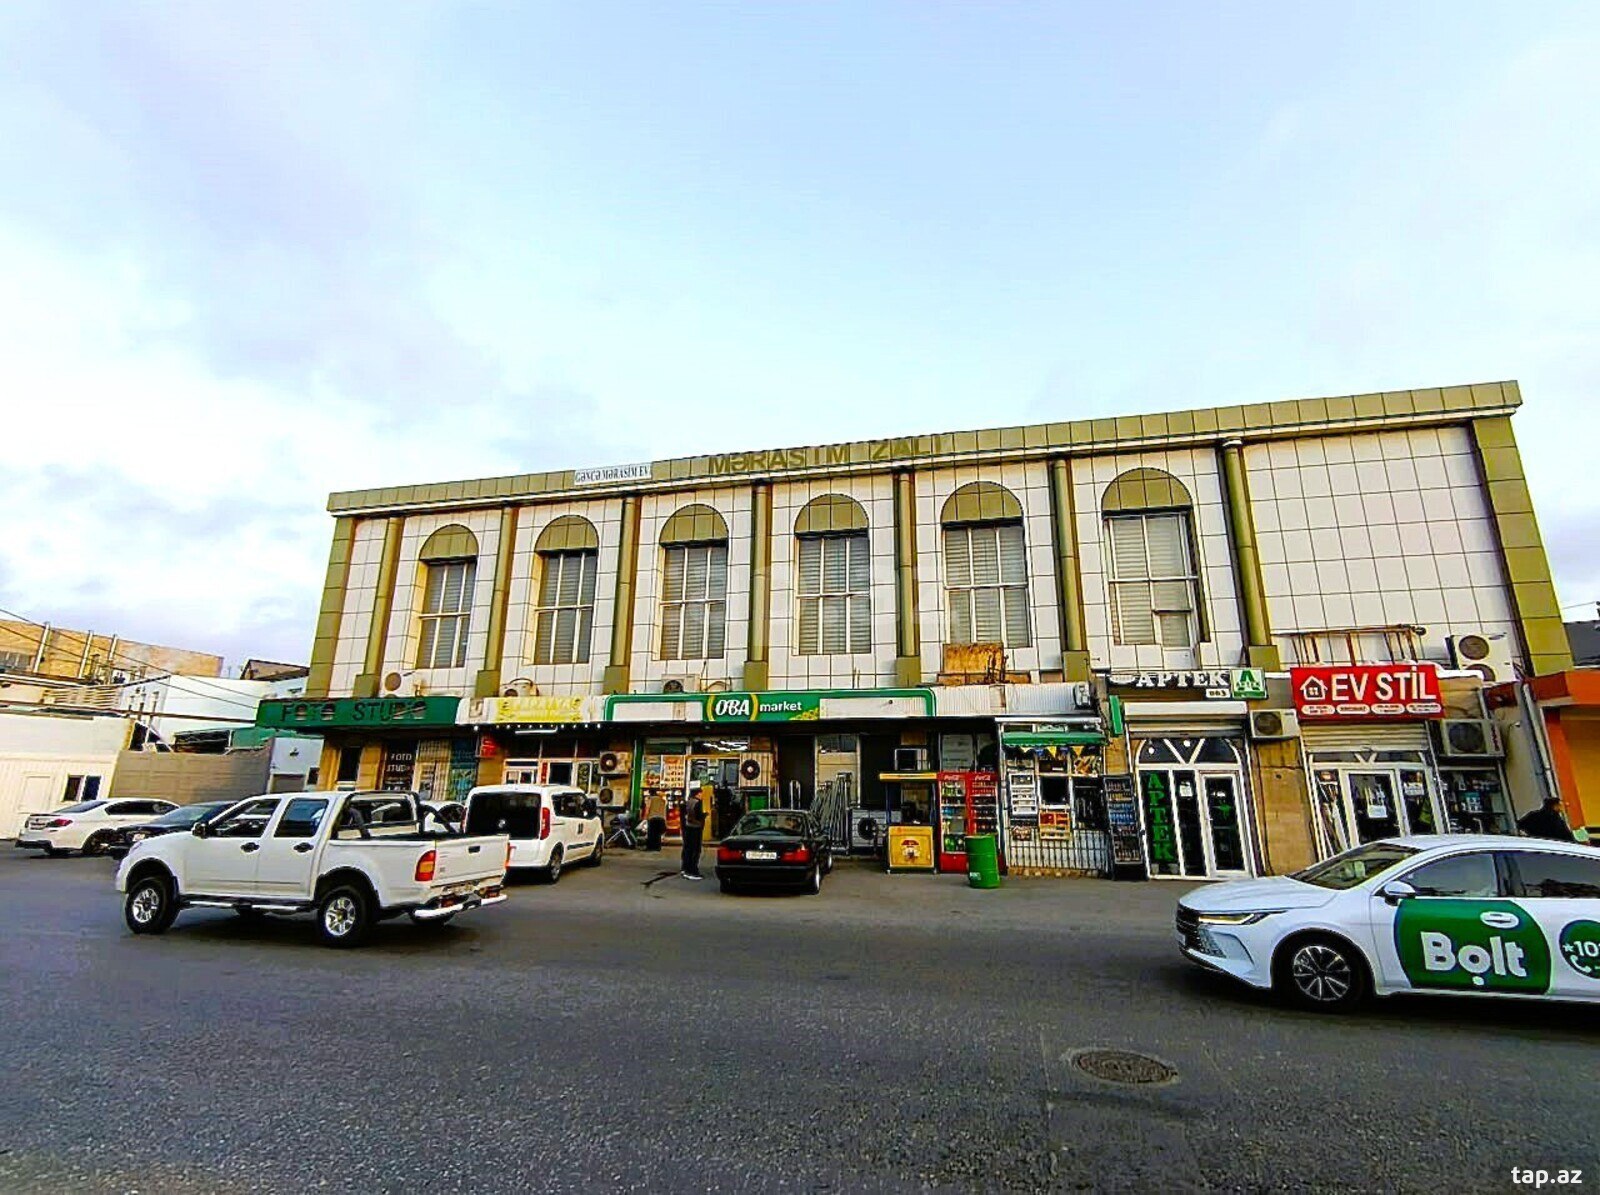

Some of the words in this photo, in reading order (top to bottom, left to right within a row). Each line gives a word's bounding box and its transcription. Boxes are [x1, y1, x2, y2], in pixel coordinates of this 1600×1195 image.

[1136, 670, 1229, 687] APTEK
[1331, 672, 1369, 701] EV
[1375, 666, 1437, 700] STİL
[715, 699, 750, 716] OBA
[760, 701, 802, 712] market
[1147, 773, 1174, 861] APTEK
[1420, 931, 1527, 986] Bolt
